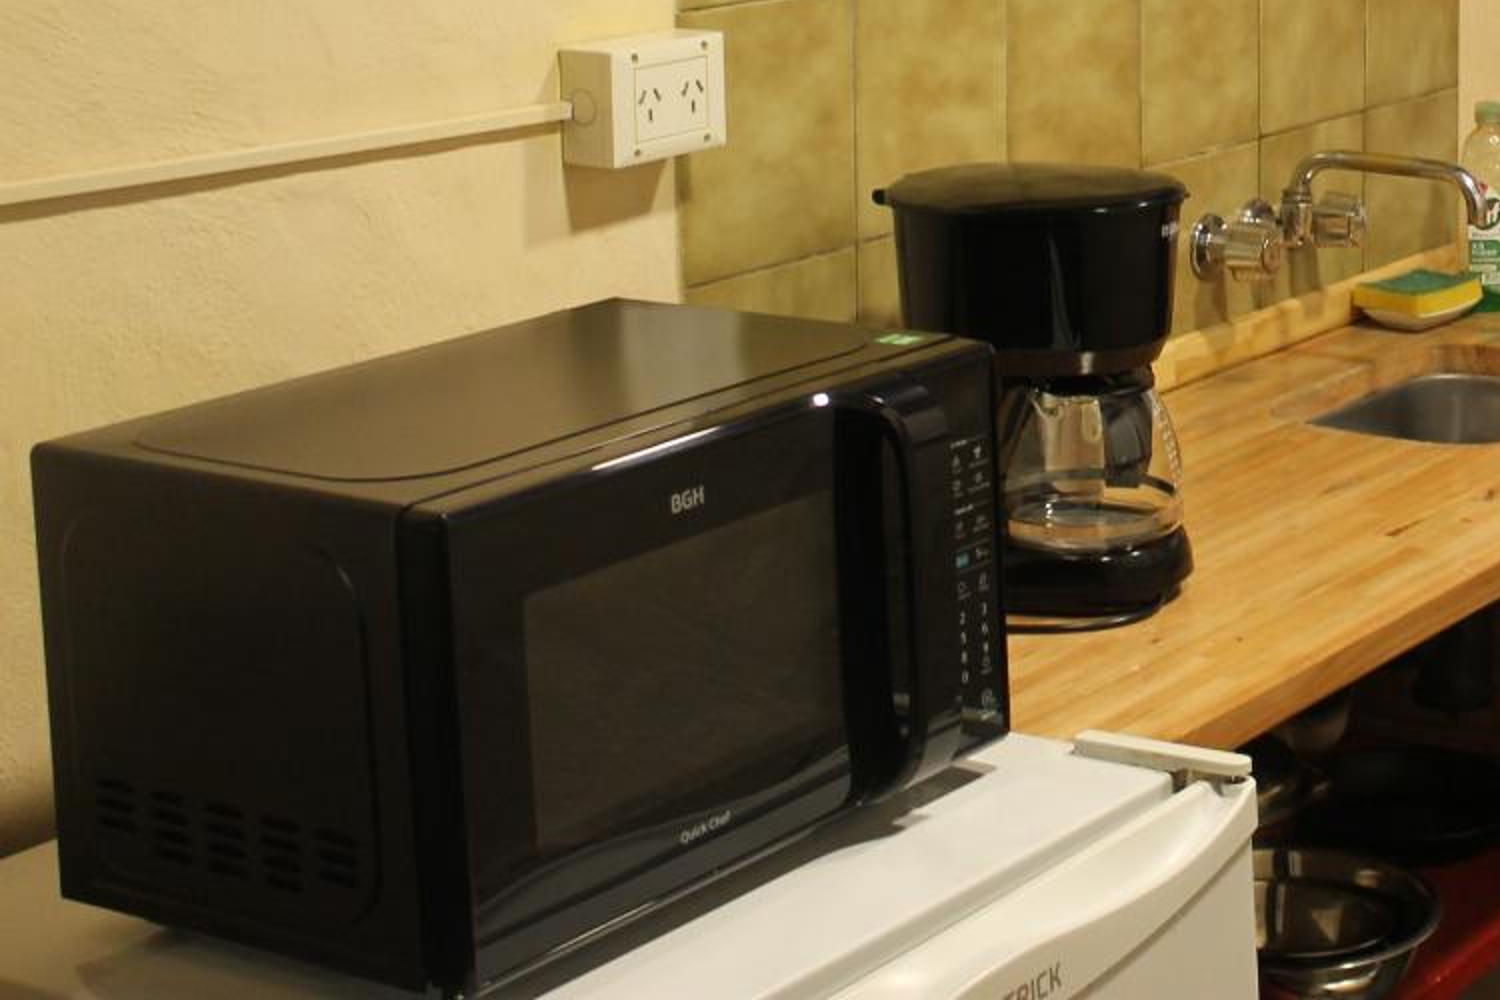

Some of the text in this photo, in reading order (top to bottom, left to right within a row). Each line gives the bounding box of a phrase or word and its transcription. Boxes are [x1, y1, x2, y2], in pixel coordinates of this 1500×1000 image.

[671, 484, 705, 515] BGH
[679, 809, 732, 845] Quick Chef
